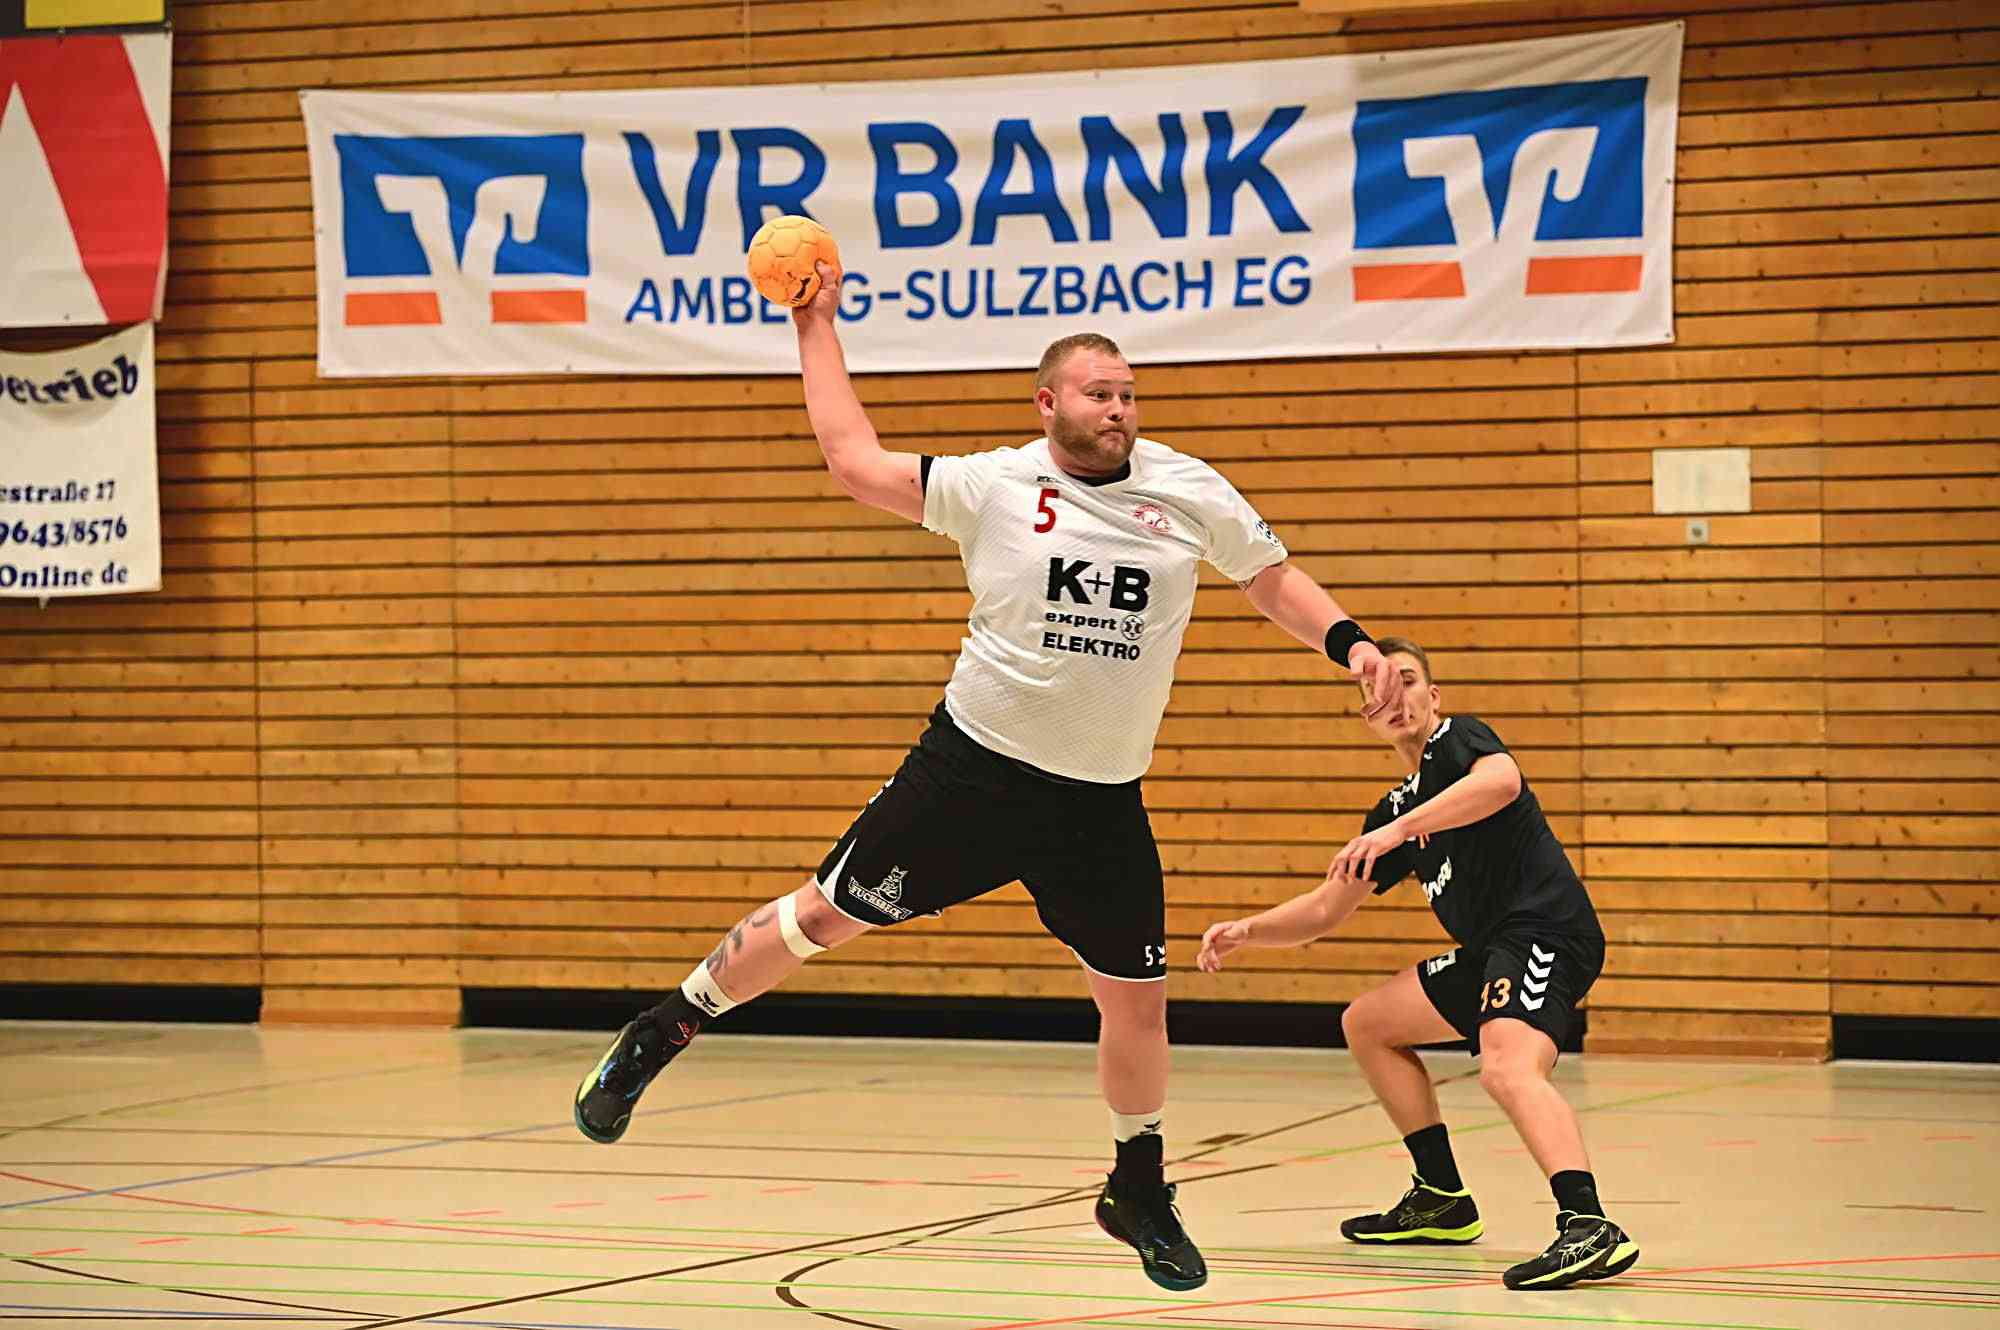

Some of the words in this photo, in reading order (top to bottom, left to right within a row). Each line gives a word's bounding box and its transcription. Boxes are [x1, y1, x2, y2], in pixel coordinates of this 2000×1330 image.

[621, 128, 828, 257] VR
[867, 105, 1313, 249] BANK
[625, 260, 1214, 324] AMBG-SULZBACH
[1233, 256, 1313, 307] EG
[0, 353, 138, 404] etrieb
[96, 480, 115, 500] 17
[1033, 488, 1059, 533] 5
[1046, 556, 1151, 613] K+B
[1045, 611, 1117, 632] expert
[1042, 631, 1141, 661] ELEKTRO
[1145, 945, 1154, 967] 5
